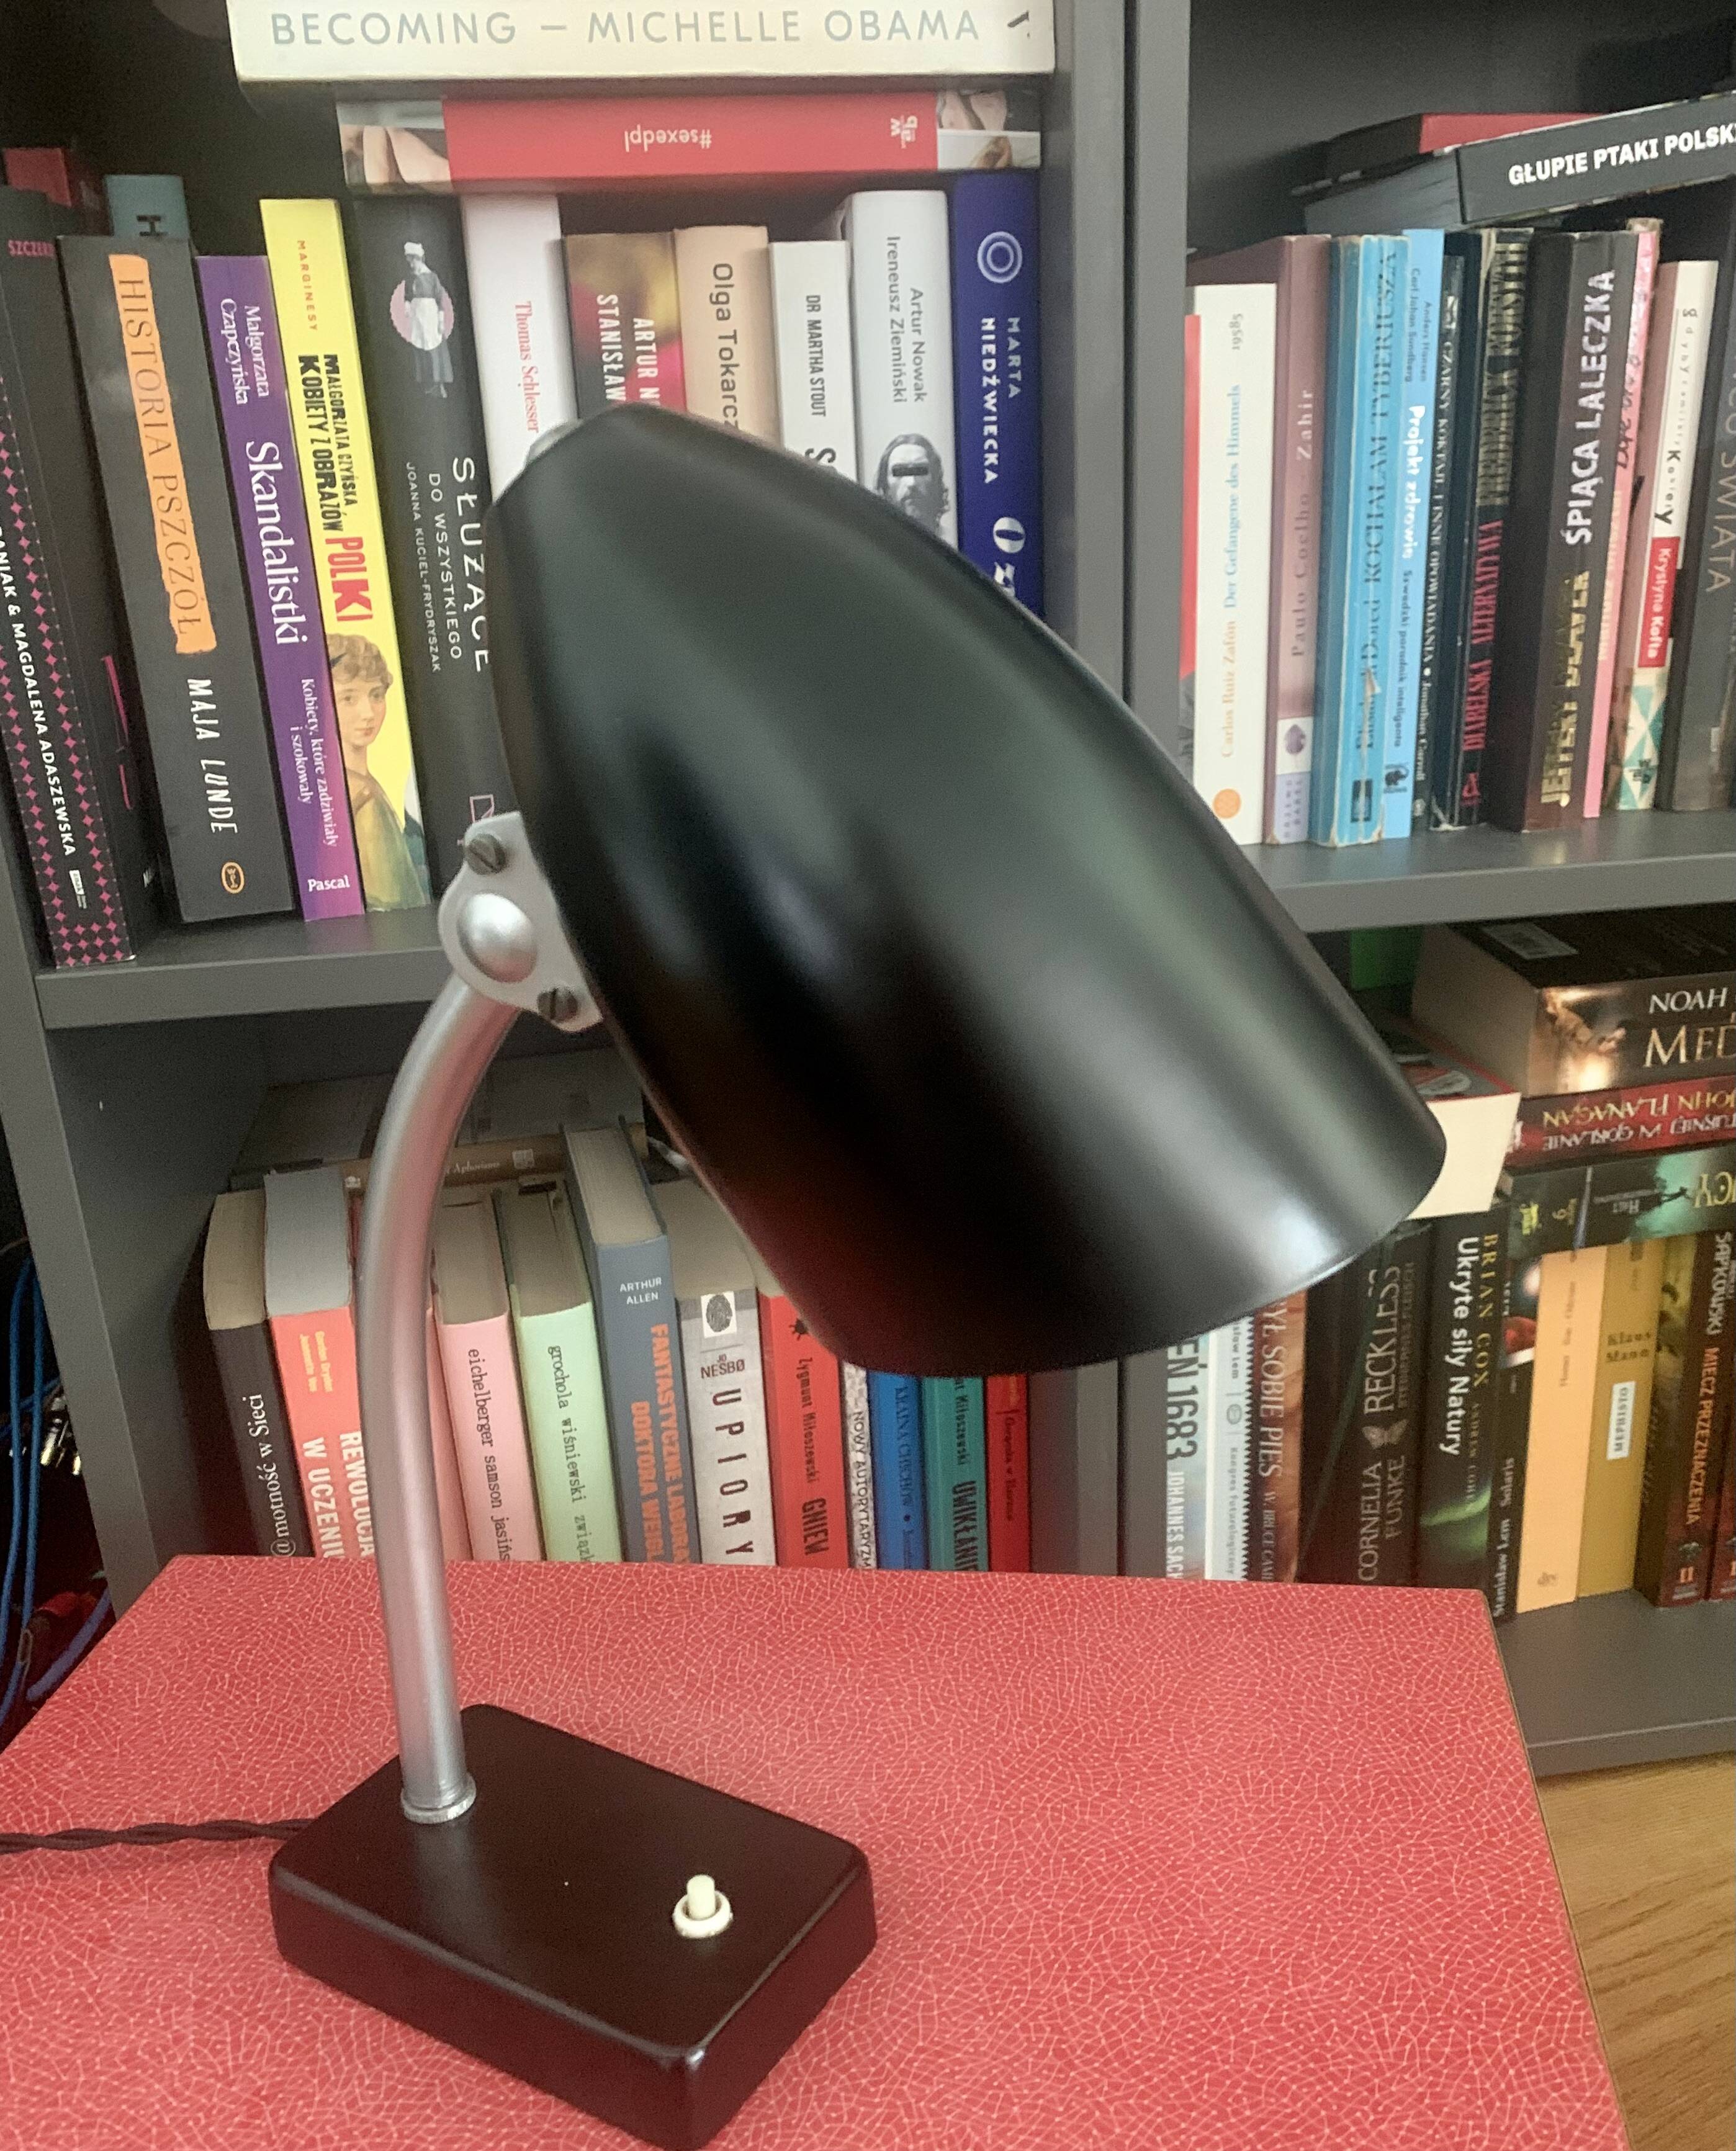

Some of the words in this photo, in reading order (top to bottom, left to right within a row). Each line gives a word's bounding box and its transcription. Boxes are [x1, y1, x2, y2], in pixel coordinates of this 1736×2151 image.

[271, 12, 516, 44] BECOMING
[588, 10, 801, 43] MICHELLE
[824, 10, 979, 42] OBAMA
[1508, 152, 1587, 186] GŁUPIE
[1593, 138, 1659, 169] PTAKI
[1665, 123, 1736, 156] POLSK
[297, 240, 317, 331] MARGINESY
[709, 263, 734, 321] Olga
[806, 295, 821, 312] DR
[887, 236, 901, 312] Ireneusz
[515, 300, 533, 361] Thomas
[807, 319, 824, 374] MARTHA
[910, 287, 924, 336] Artur
[220, 298, 250, 405] Czapczyńska
[596, 294, 626, 402] STANISŁAW
[632, 317, 658, 379] ARTUR
[890, 318, 907, 403] Ziemiński
[912, 341, 927, 403] Nowak
[1007, 317, 1022, 398] MARTA
[1575, 269, 1615, 429] LALECZKA
[298, 354, 330, 431] KOBIETY
[522, 365, 541, 433] Schlesser
[809, 377, 826, 417] STOUT
[981, 317, 1000, 484] NIEDŹWIECKA
[1226, 384, 1241, 457] Himmels
[1297, 389, 1313, 461] Zahir
[119, 279, 172, 456] HISTORIA
[152, 474, 206, 635] PSZCZÓŁ
[310, 436, 331, 446] Z
[1225, 463, 1239, 489] des
[1403, 405, 1426, 475] Projekt
[312, 449, 347, 532] OBRAZÓW
[428, 473, 443, 503] DO
[1402, 481, 1421, 559] zdrowie
[1560, 439, 1604, 546] ŚPIĄCA
[245, 440, 308, 645] Skandalistki
[406, 462, 421, 521] JOANNA
[414, 527, 441, 672] KUCIEL-FRYDRYSZAK
[1224, 496, 1242, 575] Gefangene
[1294, 494, 1310, 580] Coelho
[325, 537, 373, 622] POLKI
[434, 513, 462, 660] WSZYSTKIEGO
[1223, 580, 1236, 609] Der
[1471, 519, 1504, 645] ALTERNATYWA
[1652, 547, 1673, 614] Krystyna
[1291, 591, 1308, 658] Paulo
[1647, 616, 1664, 658] Kofta
[0, 526, 17, 597] ANIAK
[12, 622, 49, 735] MAGDALENA
[39, 739, 76, 856] ADASZEWSKA
[187, 678, 220, 740] MAJA
[301, 678, 318, 735] Kobiety,
[1222, 670, 1235, 707] Ruiz
[1463, 658, 1493, 752] DIABELSKA
[1221, 711, 1235, 758] Carlos
[200, 758, 238, 833] LUNDE
[307, 875, 351, 892] Pascal
[1648, 987, 1729, 1014] NOAH
[1542, 1093, 1669, 1129] FLANAGAN
[1693, 1171, 1736, 1208] CY
[619, 1277, 662, 1293] ARTHUR
[626, 1292, 659, 1305] ALLEN
[1449, 1237, 1480, 1319] Ukryte
[1479, 1234, 1498, 1318] BRIAN
[1706, 1231, 1732, 1336] SAPKOWSKI
[1262, 1301, 1288, 1339] YŁ
[1364, 1266, 1400, 1414] RECKLESS
[700, 1358, 745, 1379] NESBØ
[796, 1357, 813, 1408] Zygmunt
[1260, 1345, 1285, 1418] SOBIE
[1473, 1332, 1490, 1388] COX
[1699, 1347, 1720, 1397] MIECZ
[242, 1394, 269, 1437] Sieci
[468, 1348, 493, 1447] eichelberger
[483, 1455, 502, 1509] samson
[547, 1345, 572, 1409] grochola
[561, 1417, 587, 1503] wiśniewski
[650, 1323, 682, 1481] FANTASTYCZNE
[853, 1411, 867, 1456] NOWY
[1166, 1383, 1199, 1462] 1683
[1439, 1376, 1471, 1455] Natury
[258, 1442, 274, 1458] w
[302, 1437, 327, 1458] W
[630, 1401, 659, 1495] DOKTORA
[711, 1388, 755, 1555] UPIORY
[1258, 1427, 1284, 1478] PIES
[340, 1430, 375, 1557] REWOLUCJA
[801, 1497, 829, 1555] GNIEW
[1166, 1471, 1184, 1543] JOHANNES
[1358, 1461, 1382, 1581] CORNELIA
[1385, 1455, 1405, 1539] FUNKE
